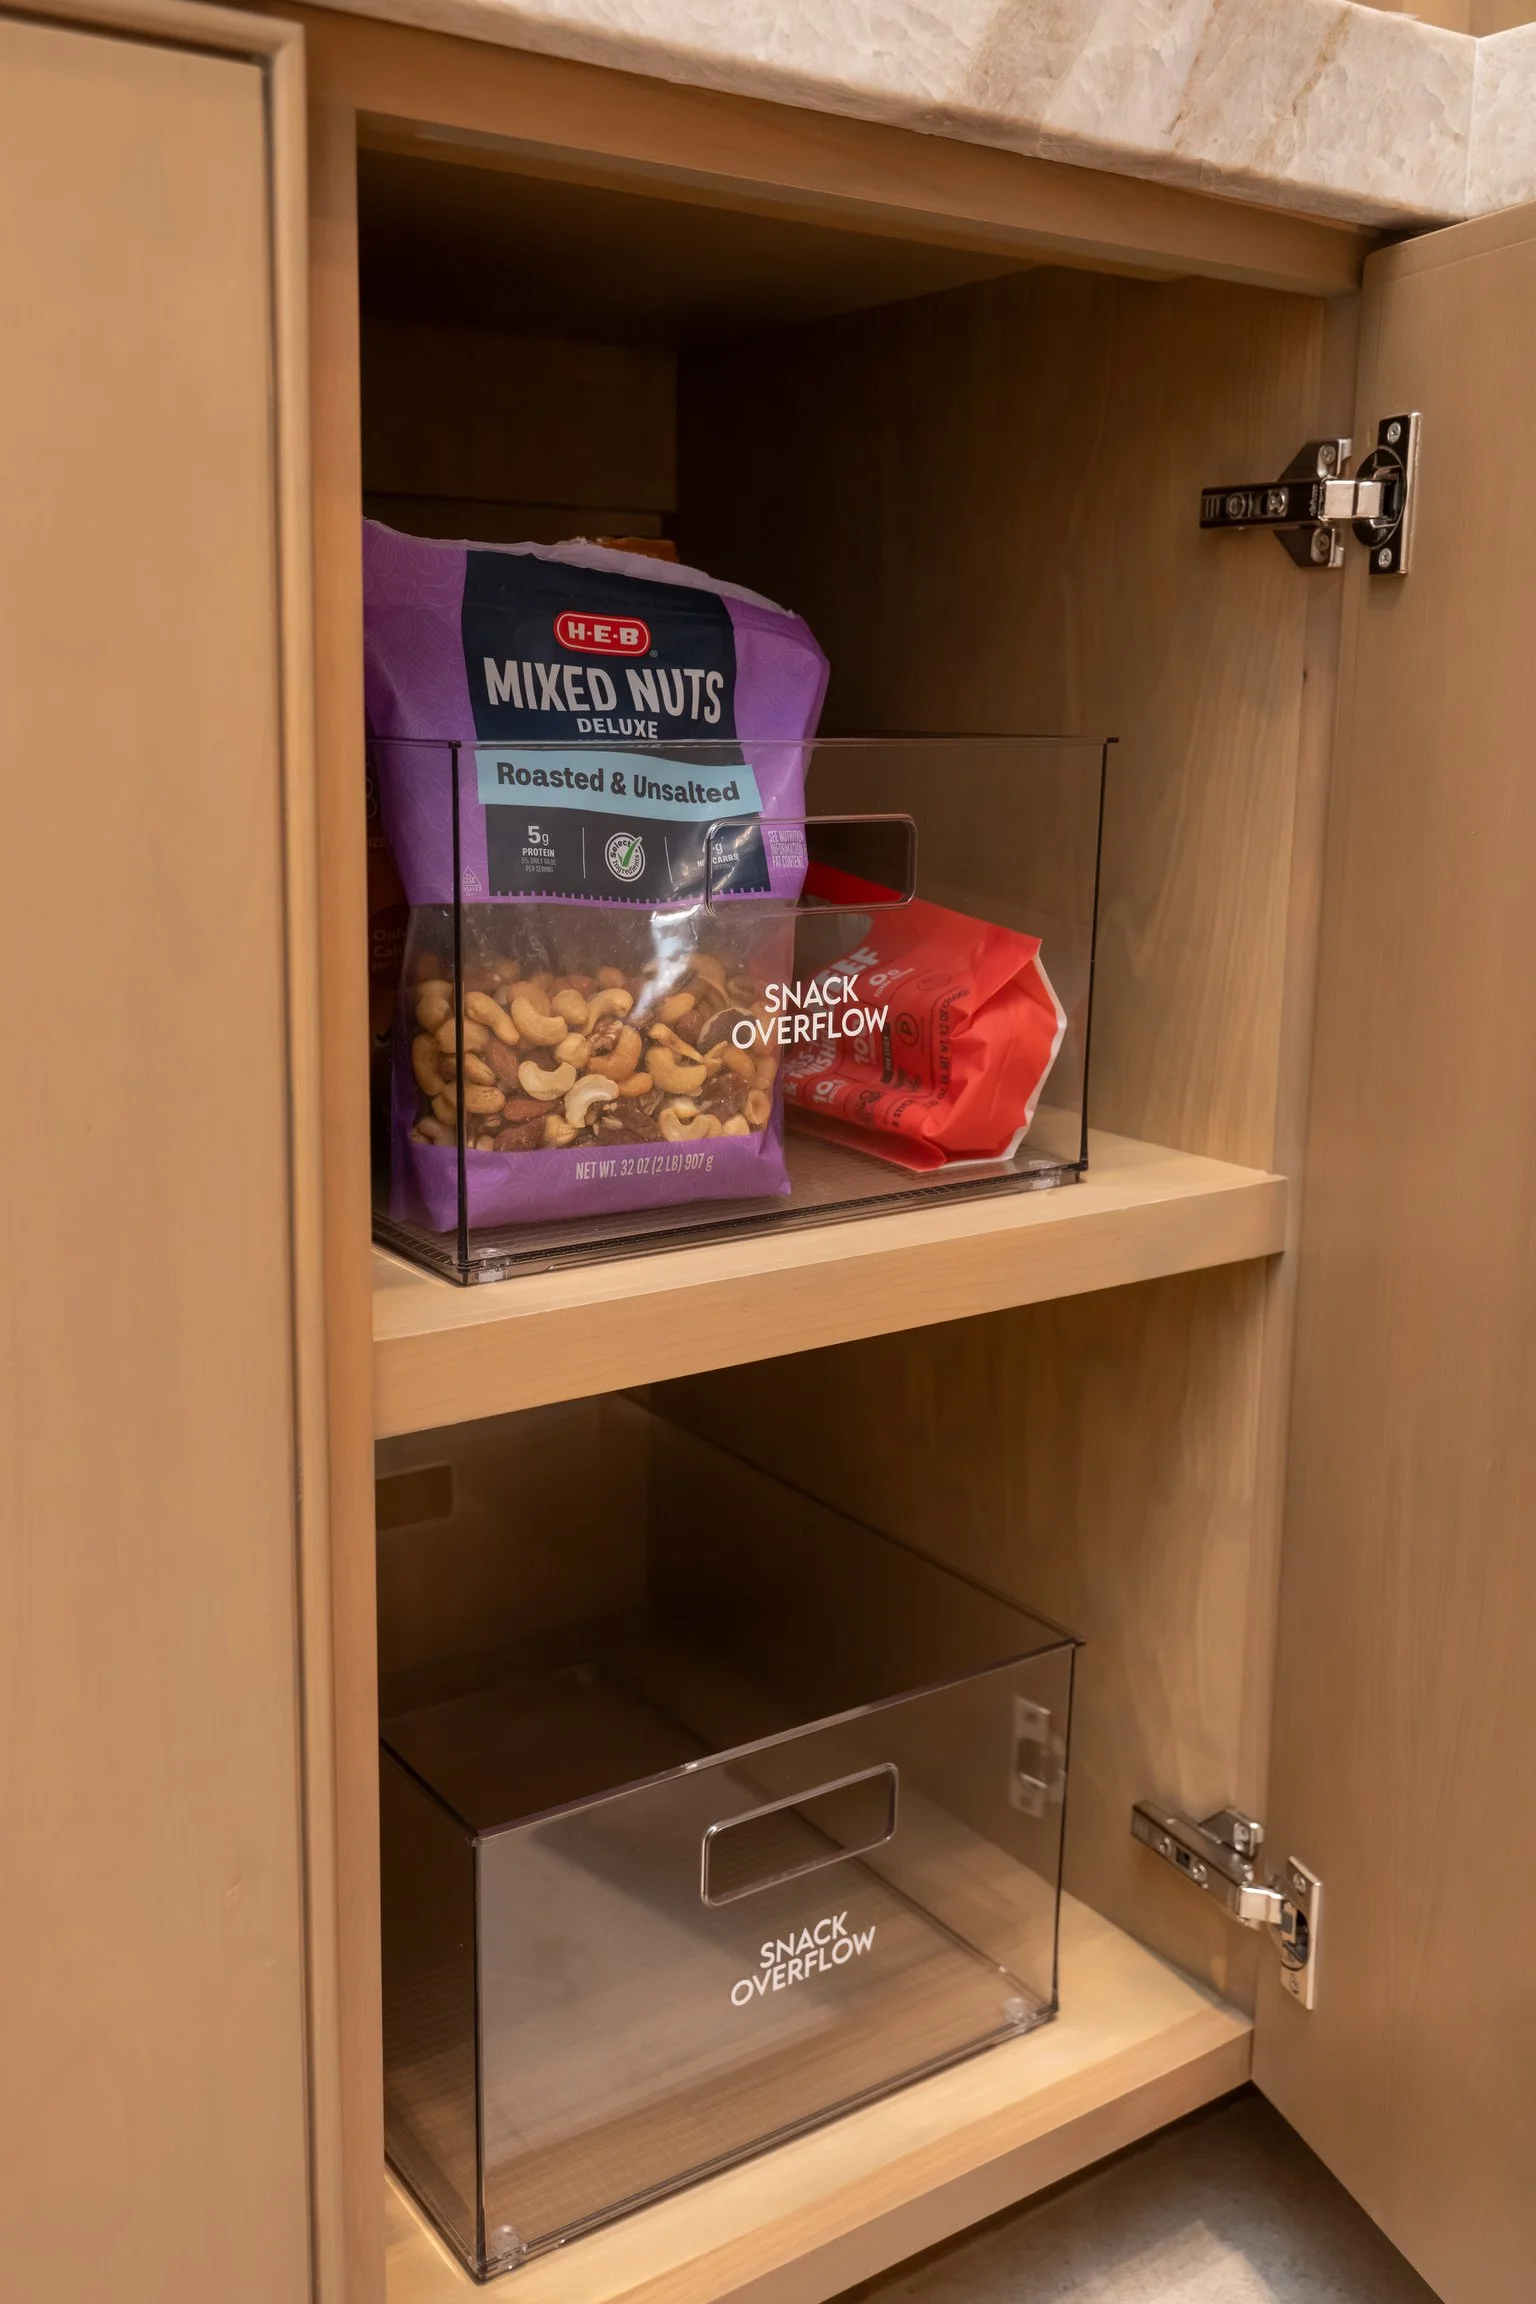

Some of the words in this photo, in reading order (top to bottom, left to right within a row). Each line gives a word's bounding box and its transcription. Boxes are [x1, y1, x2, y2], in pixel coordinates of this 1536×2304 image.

[483, 657, 617, 712] MIXED
[625, 668, 725, 725] NUTS
[576, 717, 659, 740] DELUXE
[496, 761, 605, 793] Roasted
[610, 772, 627, 796] &
[633, 774, 741, 804] Unsalted
[611, 839, 632, 859] Select
[767, 830, 779, 843] SEE
[522, 847, 556, 858] PROTEIN
[612, 854, 641, 876] Ingredients
[712, 852, 740, 866] CARBS
[525, 865, 536, 873] PER
[535, 865, 555, 874] SERVING
[764, 974, 860, 1013] SNACK
[731, 1005, 889, 1049] OVERFLOW
[575, 1161, 597, 1181] NET
[599, 1159, 617, 1178] WT.
[620, 1158, 634, 1177] 32
[636, 1157, 650, 1175] OZ
[651, 1155, 663, 1176] (2
[665, 1154, 683, 1174] LB)
[685, 1153, 705, 1171] 907
[705, 1155, 714, 1172] g
[760, 1911, 848, 1968] SNACK
[731, 1925, 877, 2006] OVERFLOW
